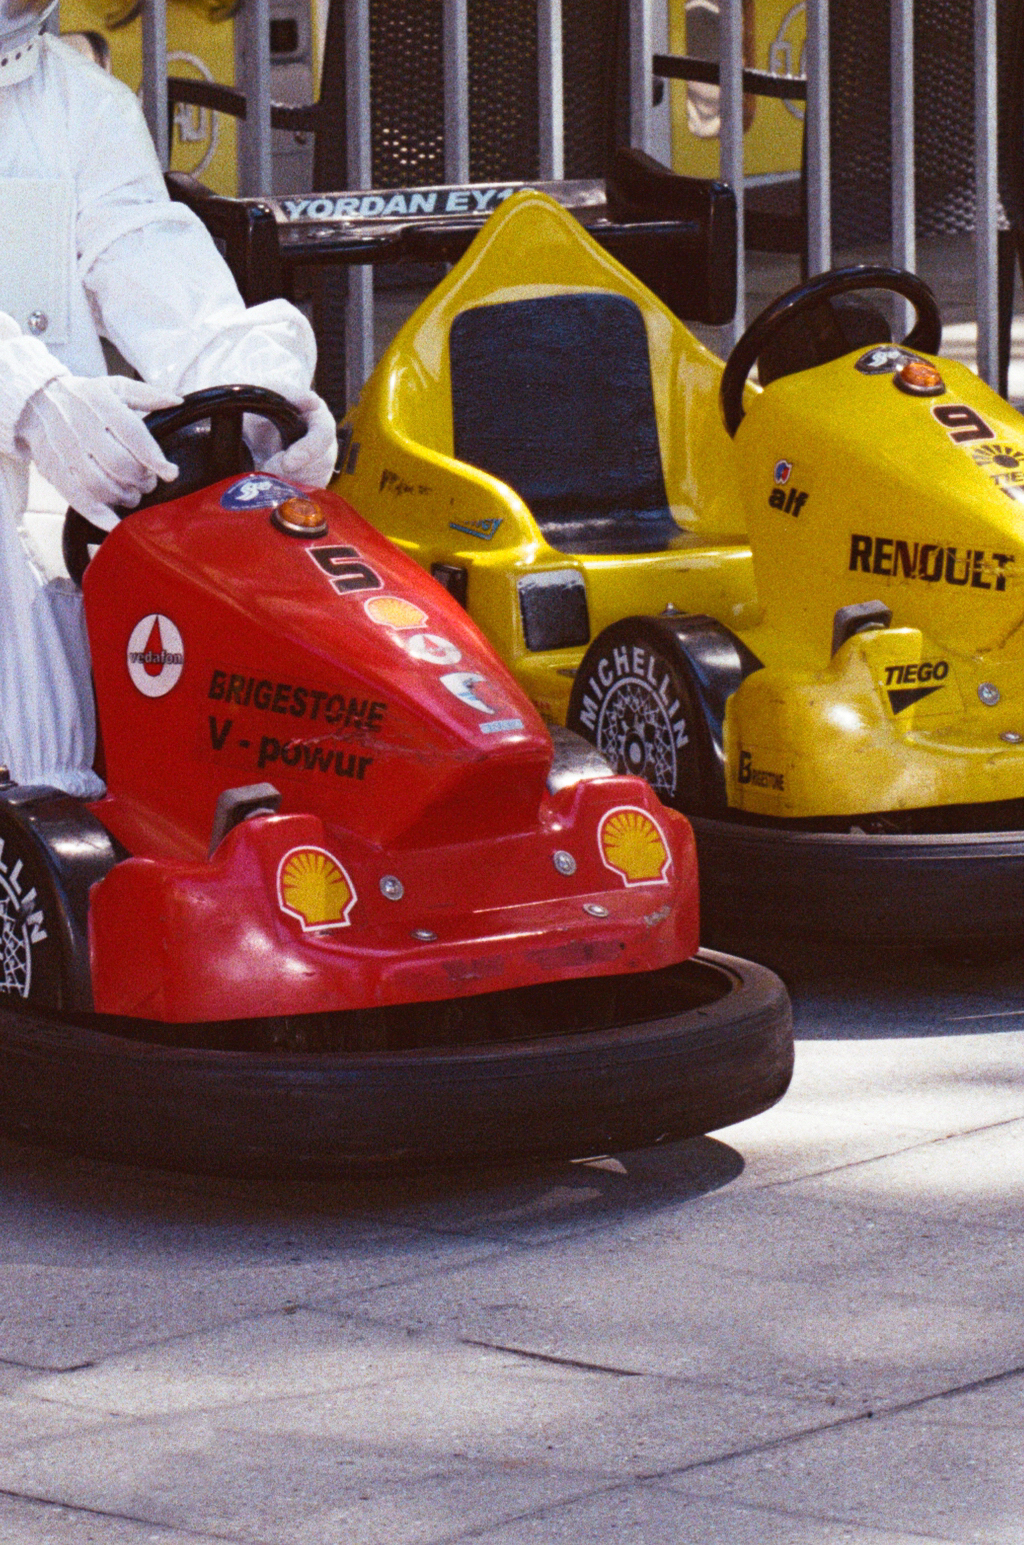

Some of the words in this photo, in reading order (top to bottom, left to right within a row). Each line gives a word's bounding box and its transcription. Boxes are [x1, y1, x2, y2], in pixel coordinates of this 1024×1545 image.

[283, 193, 439, 221] YORDAN
[930, 405, 996, 444] 9
[768, 487, 810, 518] alf
[305, 545, 384, 595] 5
[130, 649, 184, 665] vedafon
[884, 660, 950, 686] TIEGO
[208, 669, 387, 732] BRIGESTONE
[579, 645, 690, 750] MICHELLIN
[208, 715, 233, 751] V
[257, 735, 374, 781] powur
